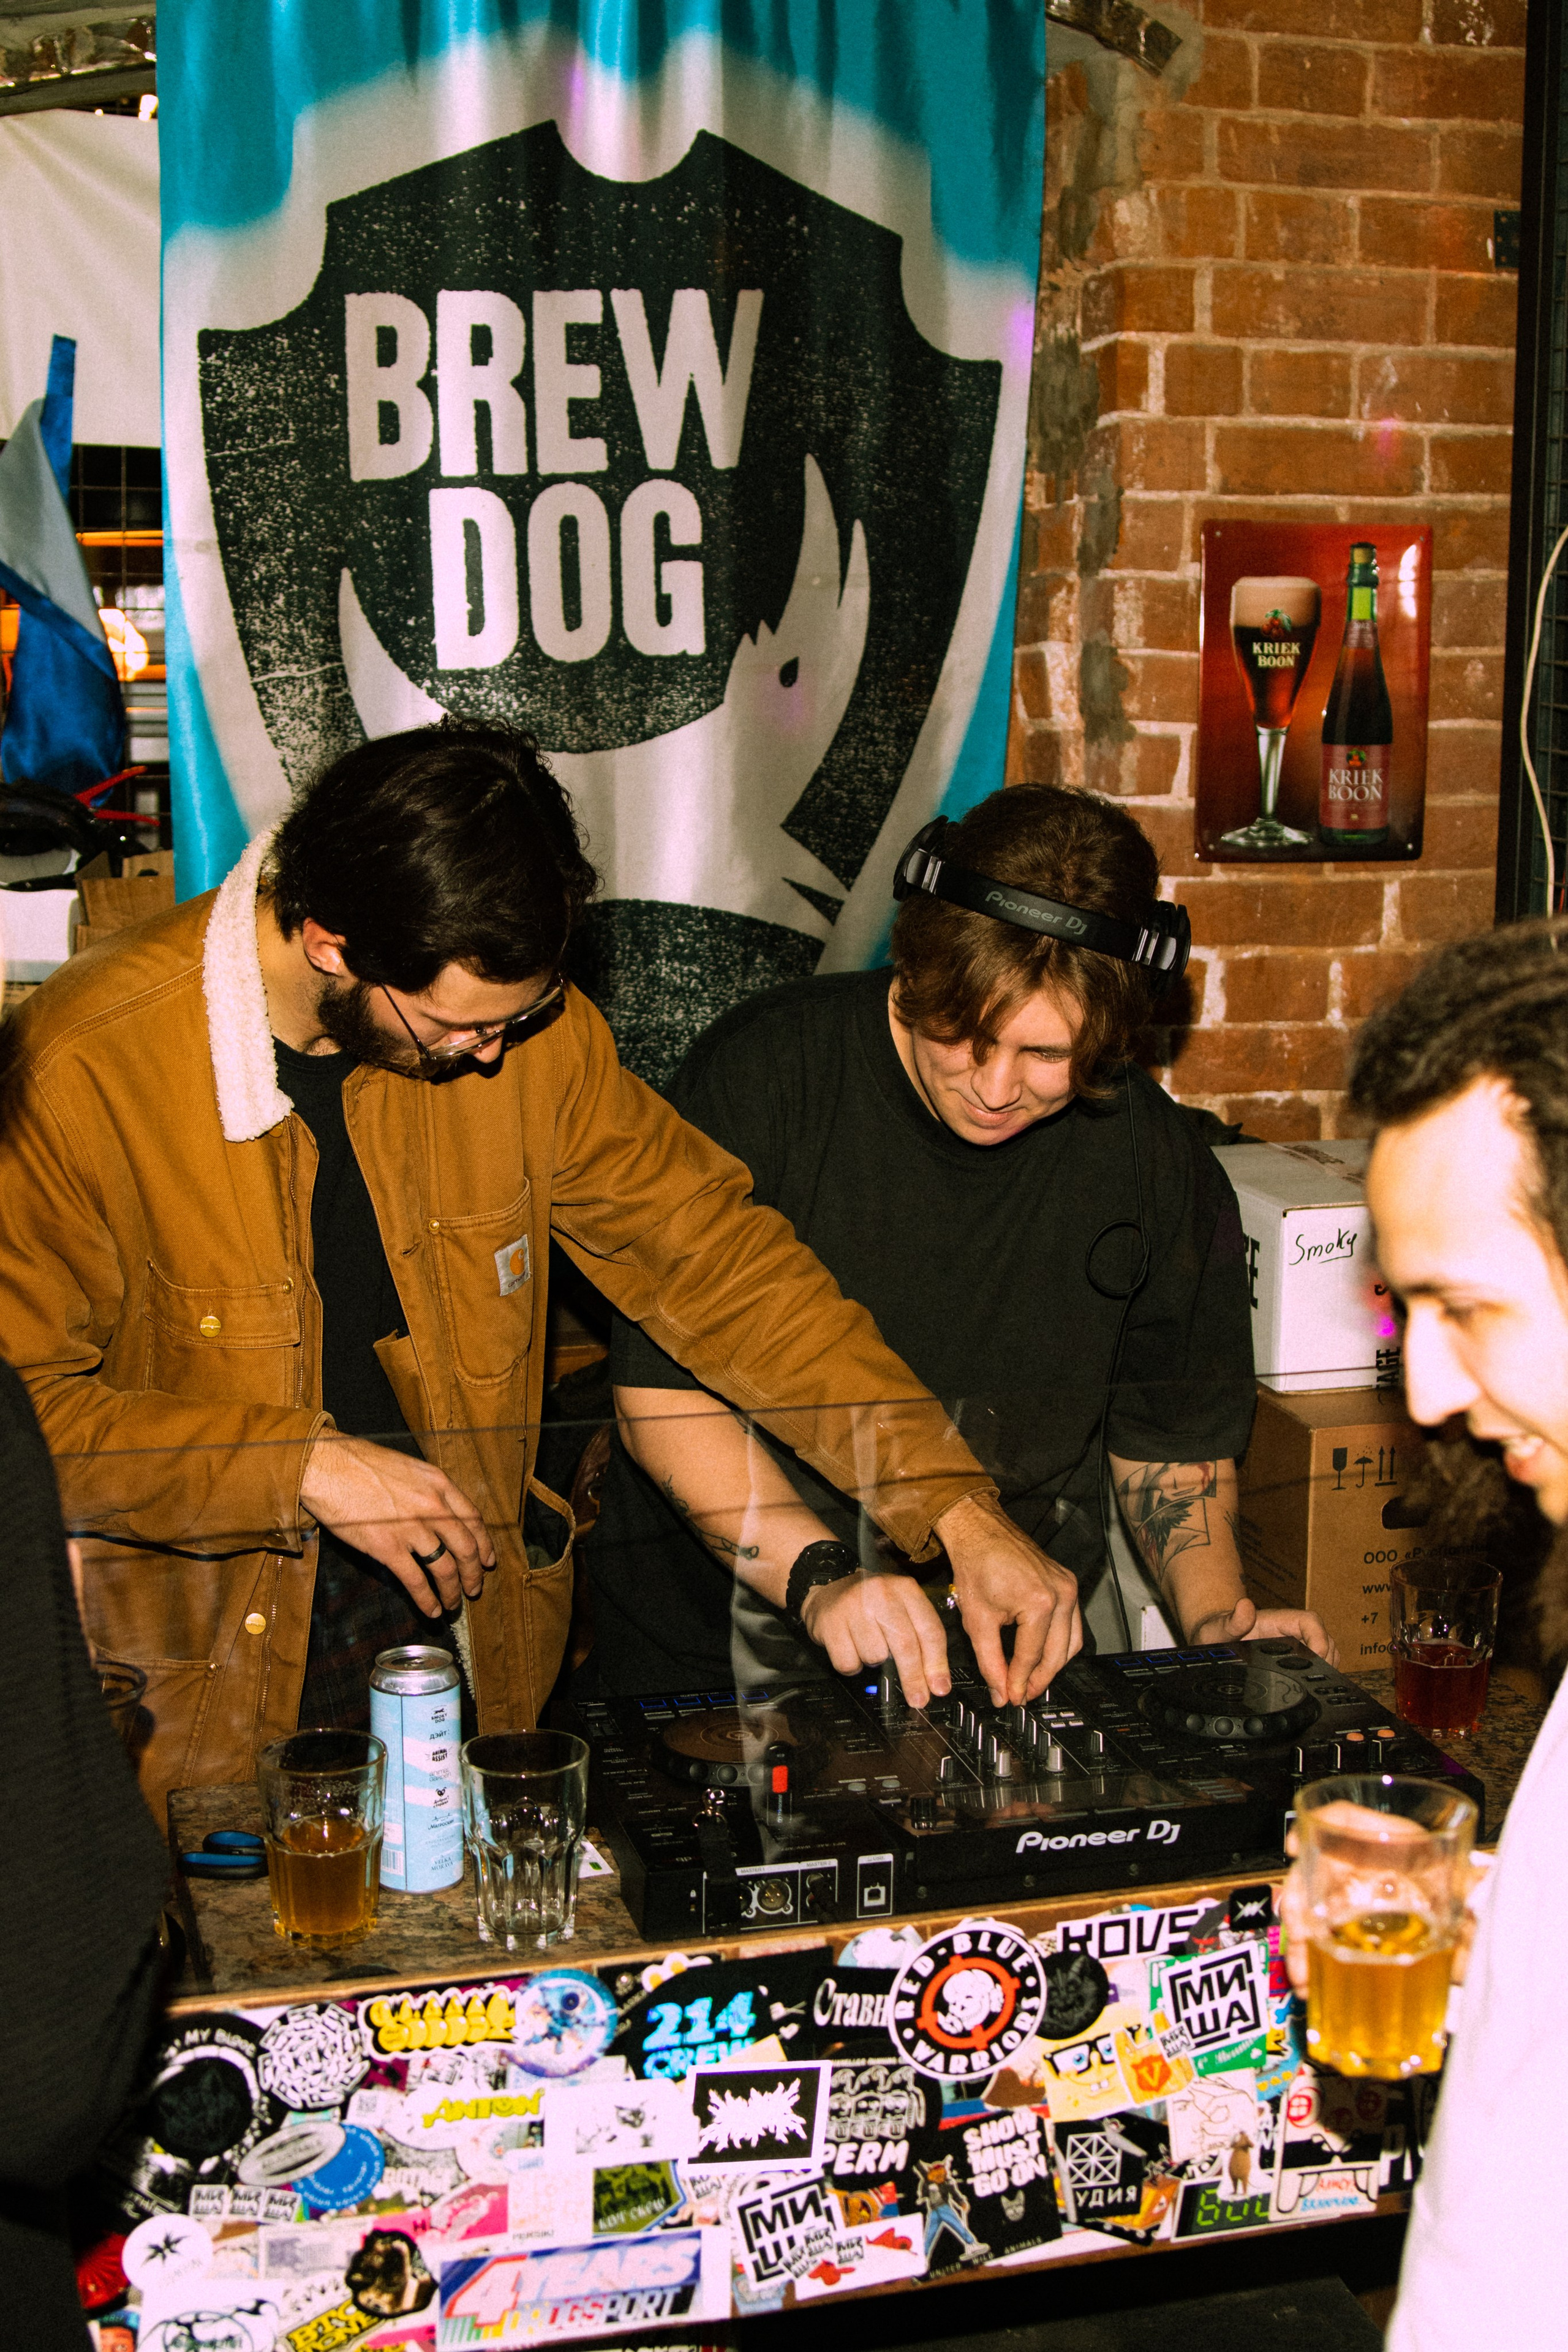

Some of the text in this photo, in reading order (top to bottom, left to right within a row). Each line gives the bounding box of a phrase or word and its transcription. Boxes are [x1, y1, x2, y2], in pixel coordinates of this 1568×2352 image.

[344, 288, 764, 483] BREW
[429, 478, 706, 670] DOG
[1252, 642, 1300, 655] KRIEK
[1257, 654, 1295, 668] BOON
[1328, 785, 1383, 802] BOON
[1329, 768, 1383, 785] KRIEK
[984, 890, 1064, 926] Pioneer
[1289, 1228, 1357, 1265] Smoky
[1016, 1828, 1140, 1853] Pioneer
[643, 1991, 756, 2051] 214
[911, 1994, 1041, 2074] WARRIORS
[963, 2109, 1038, 2150] SHOW
[967, 2131, 1042, 2175] MUST
[969, 2154, 1048, 2198] GO ON
[929, 2262, 962, 2279] UNITED
[1004, 2236, 1042, 2254] ANIMALS
[445, 2254, 527, 2328] 4
[527, 2239, 700, 2301] YEARS
